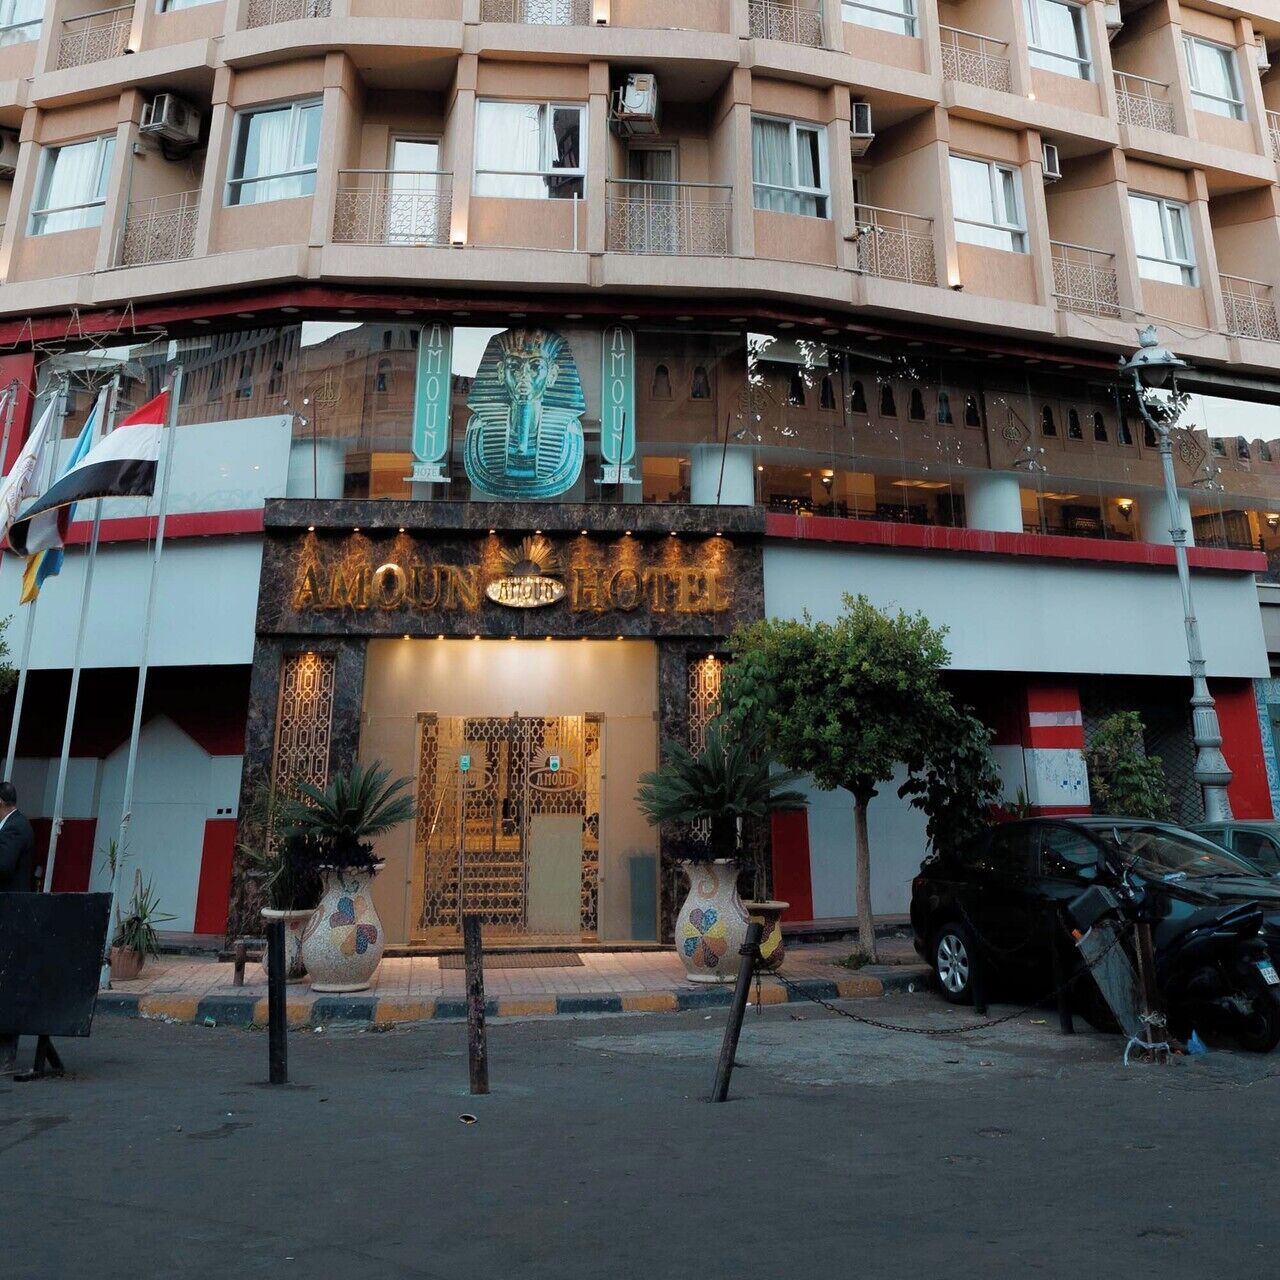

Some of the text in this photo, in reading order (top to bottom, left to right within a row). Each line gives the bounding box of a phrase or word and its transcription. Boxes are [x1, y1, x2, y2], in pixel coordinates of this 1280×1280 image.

[422, 323, 443, 457] AMOUN
[610, 326, 627, 459] AMOUN
[293, 564, 730, 614] AMOUN HOTEL
[497, 580, 556, 601] AMOUN
